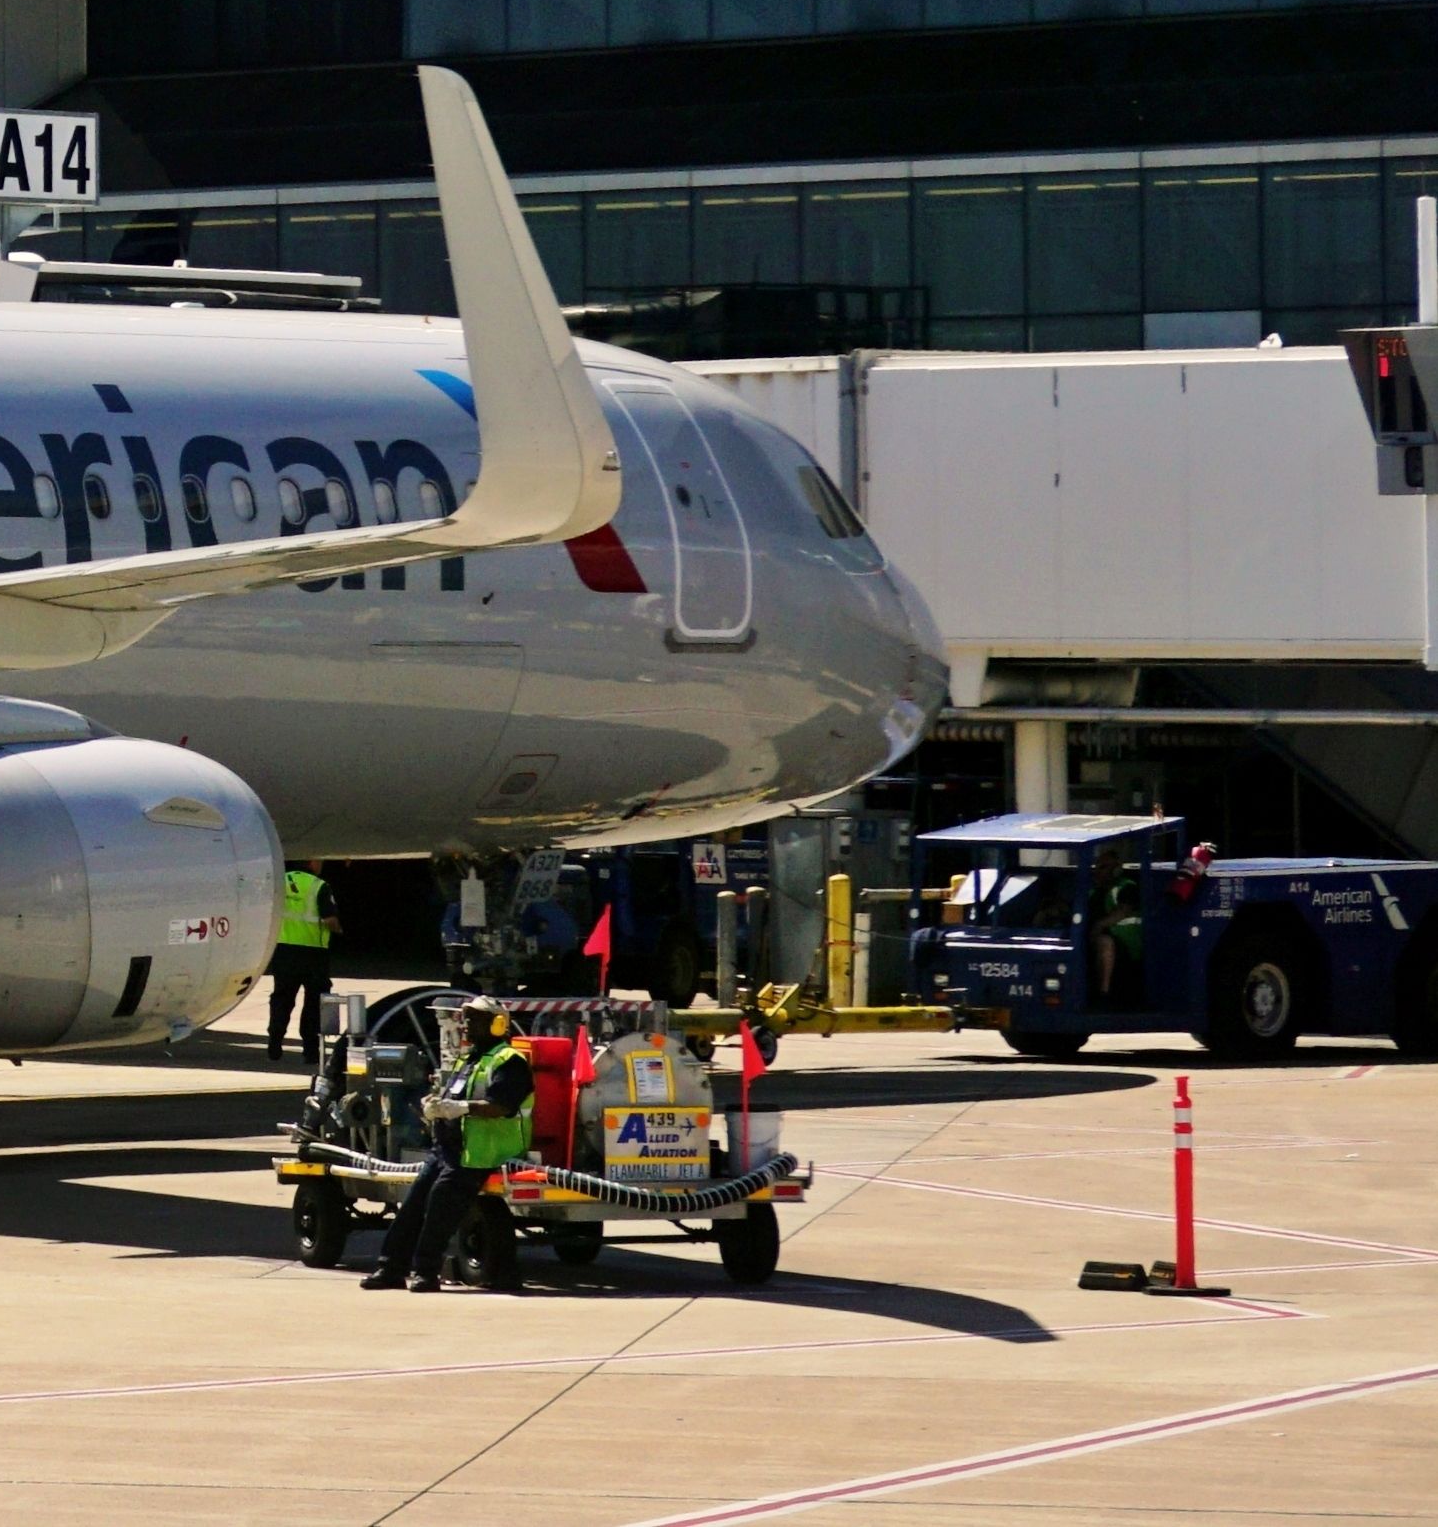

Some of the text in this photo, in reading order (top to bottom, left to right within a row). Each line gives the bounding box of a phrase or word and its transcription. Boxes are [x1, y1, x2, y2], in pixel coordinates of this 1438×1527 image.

[528, 854, 562, 871] A321
[519, 879, 554, 899] 868
[1288, 881, 1310, 894] A14
[1311, 887, 1373, 906] American
[1324, 907, 1373, 924] Airlines
[980, 962, 1020, 978] 12584
[1008, 984, 1033, 996] A14
[646, 1112, 676, 1126] 439
[638, 1145, 698, 1158] AVIATION
[609, 1164, 668, 1180] FLAMMABLE
[678, 1164, 693, 1179] JET
